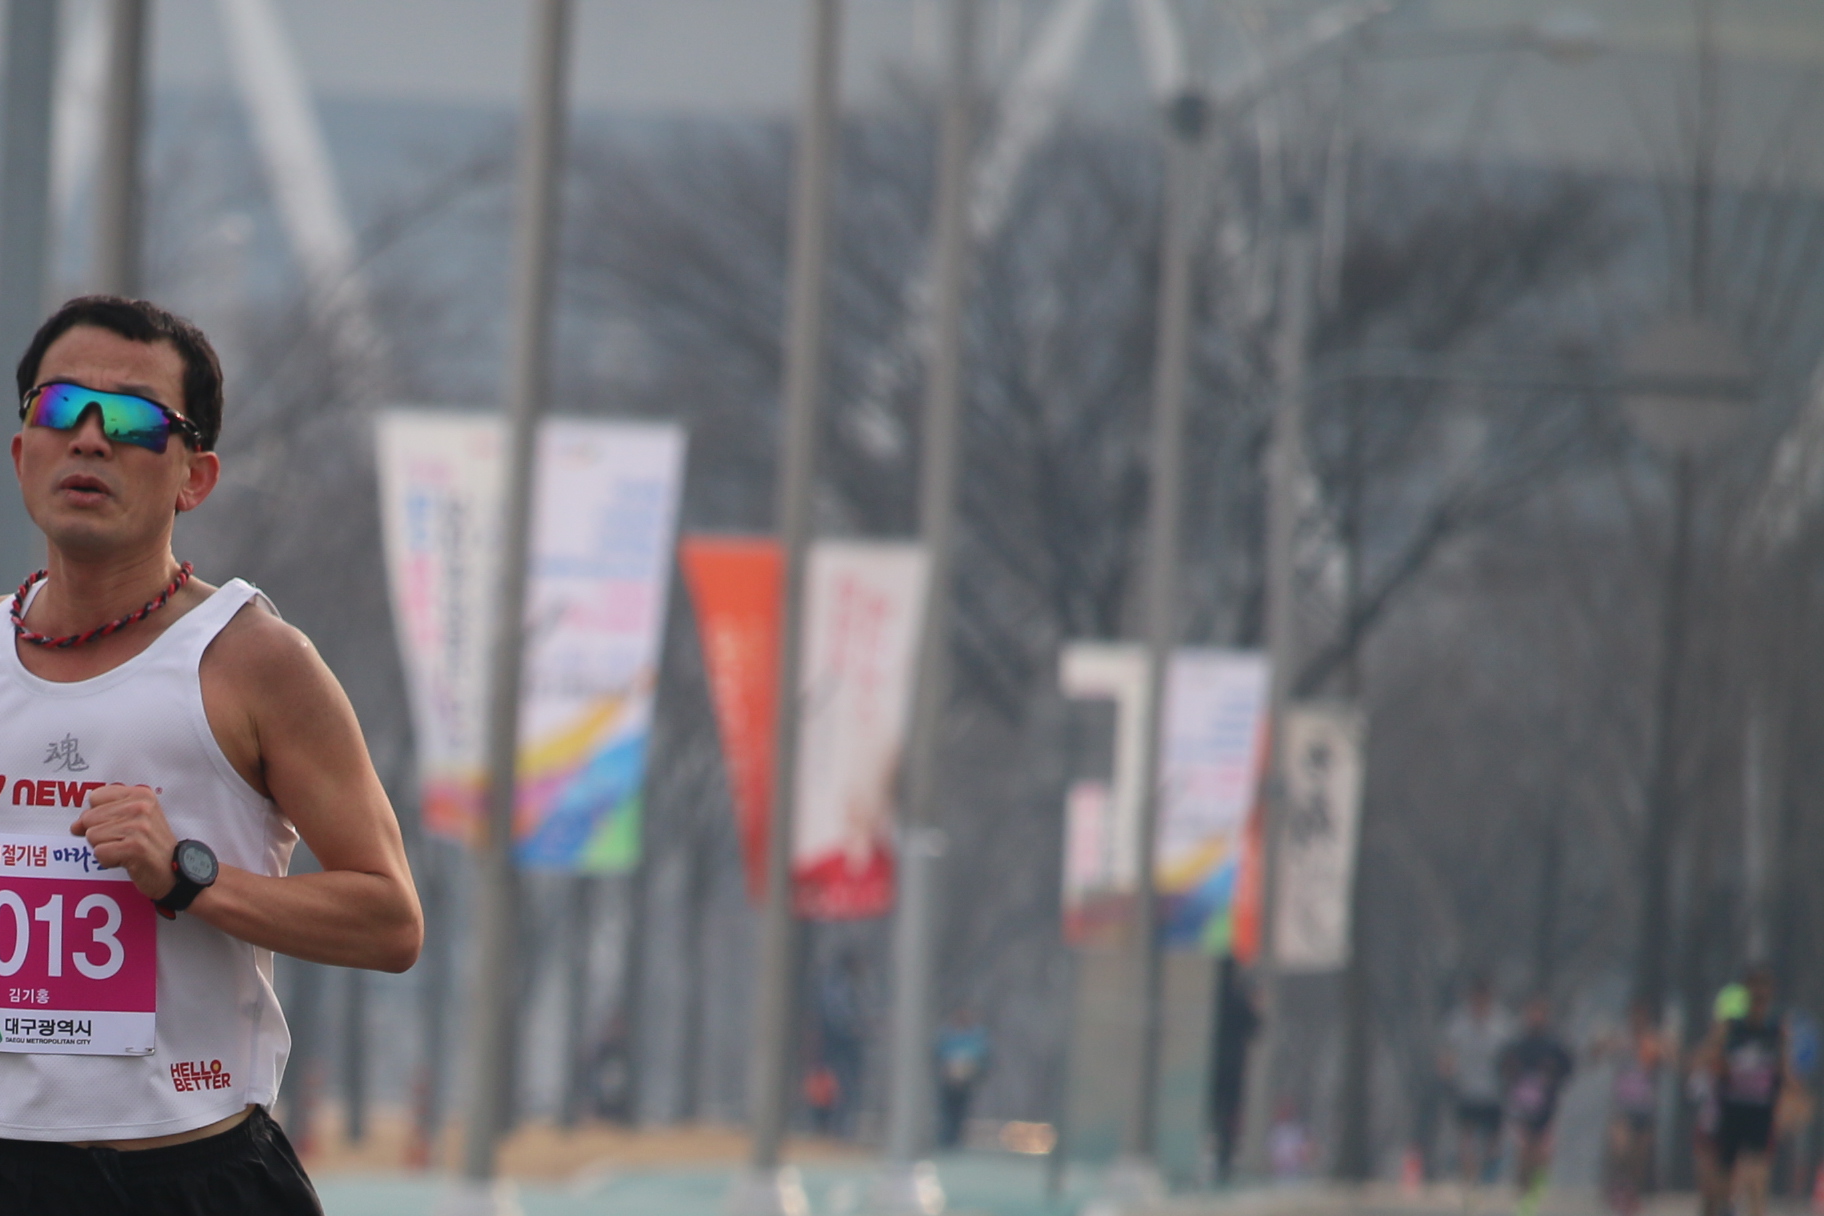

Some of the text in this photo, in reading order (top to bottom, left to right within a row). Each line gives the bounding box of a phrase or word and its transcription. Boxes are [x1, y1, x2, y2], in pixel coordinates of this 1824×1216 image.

[43, 732, 90, 772] 魂
[8, 988, 50, 1004] 김기홍
[4, 1017, 92, 1036] 대구광역시
[5, 1036, 25, 1044] DAEGU
[170, 1059, 222, 1078] HELLO
[173, 1072, 232, 1092] BETTER
